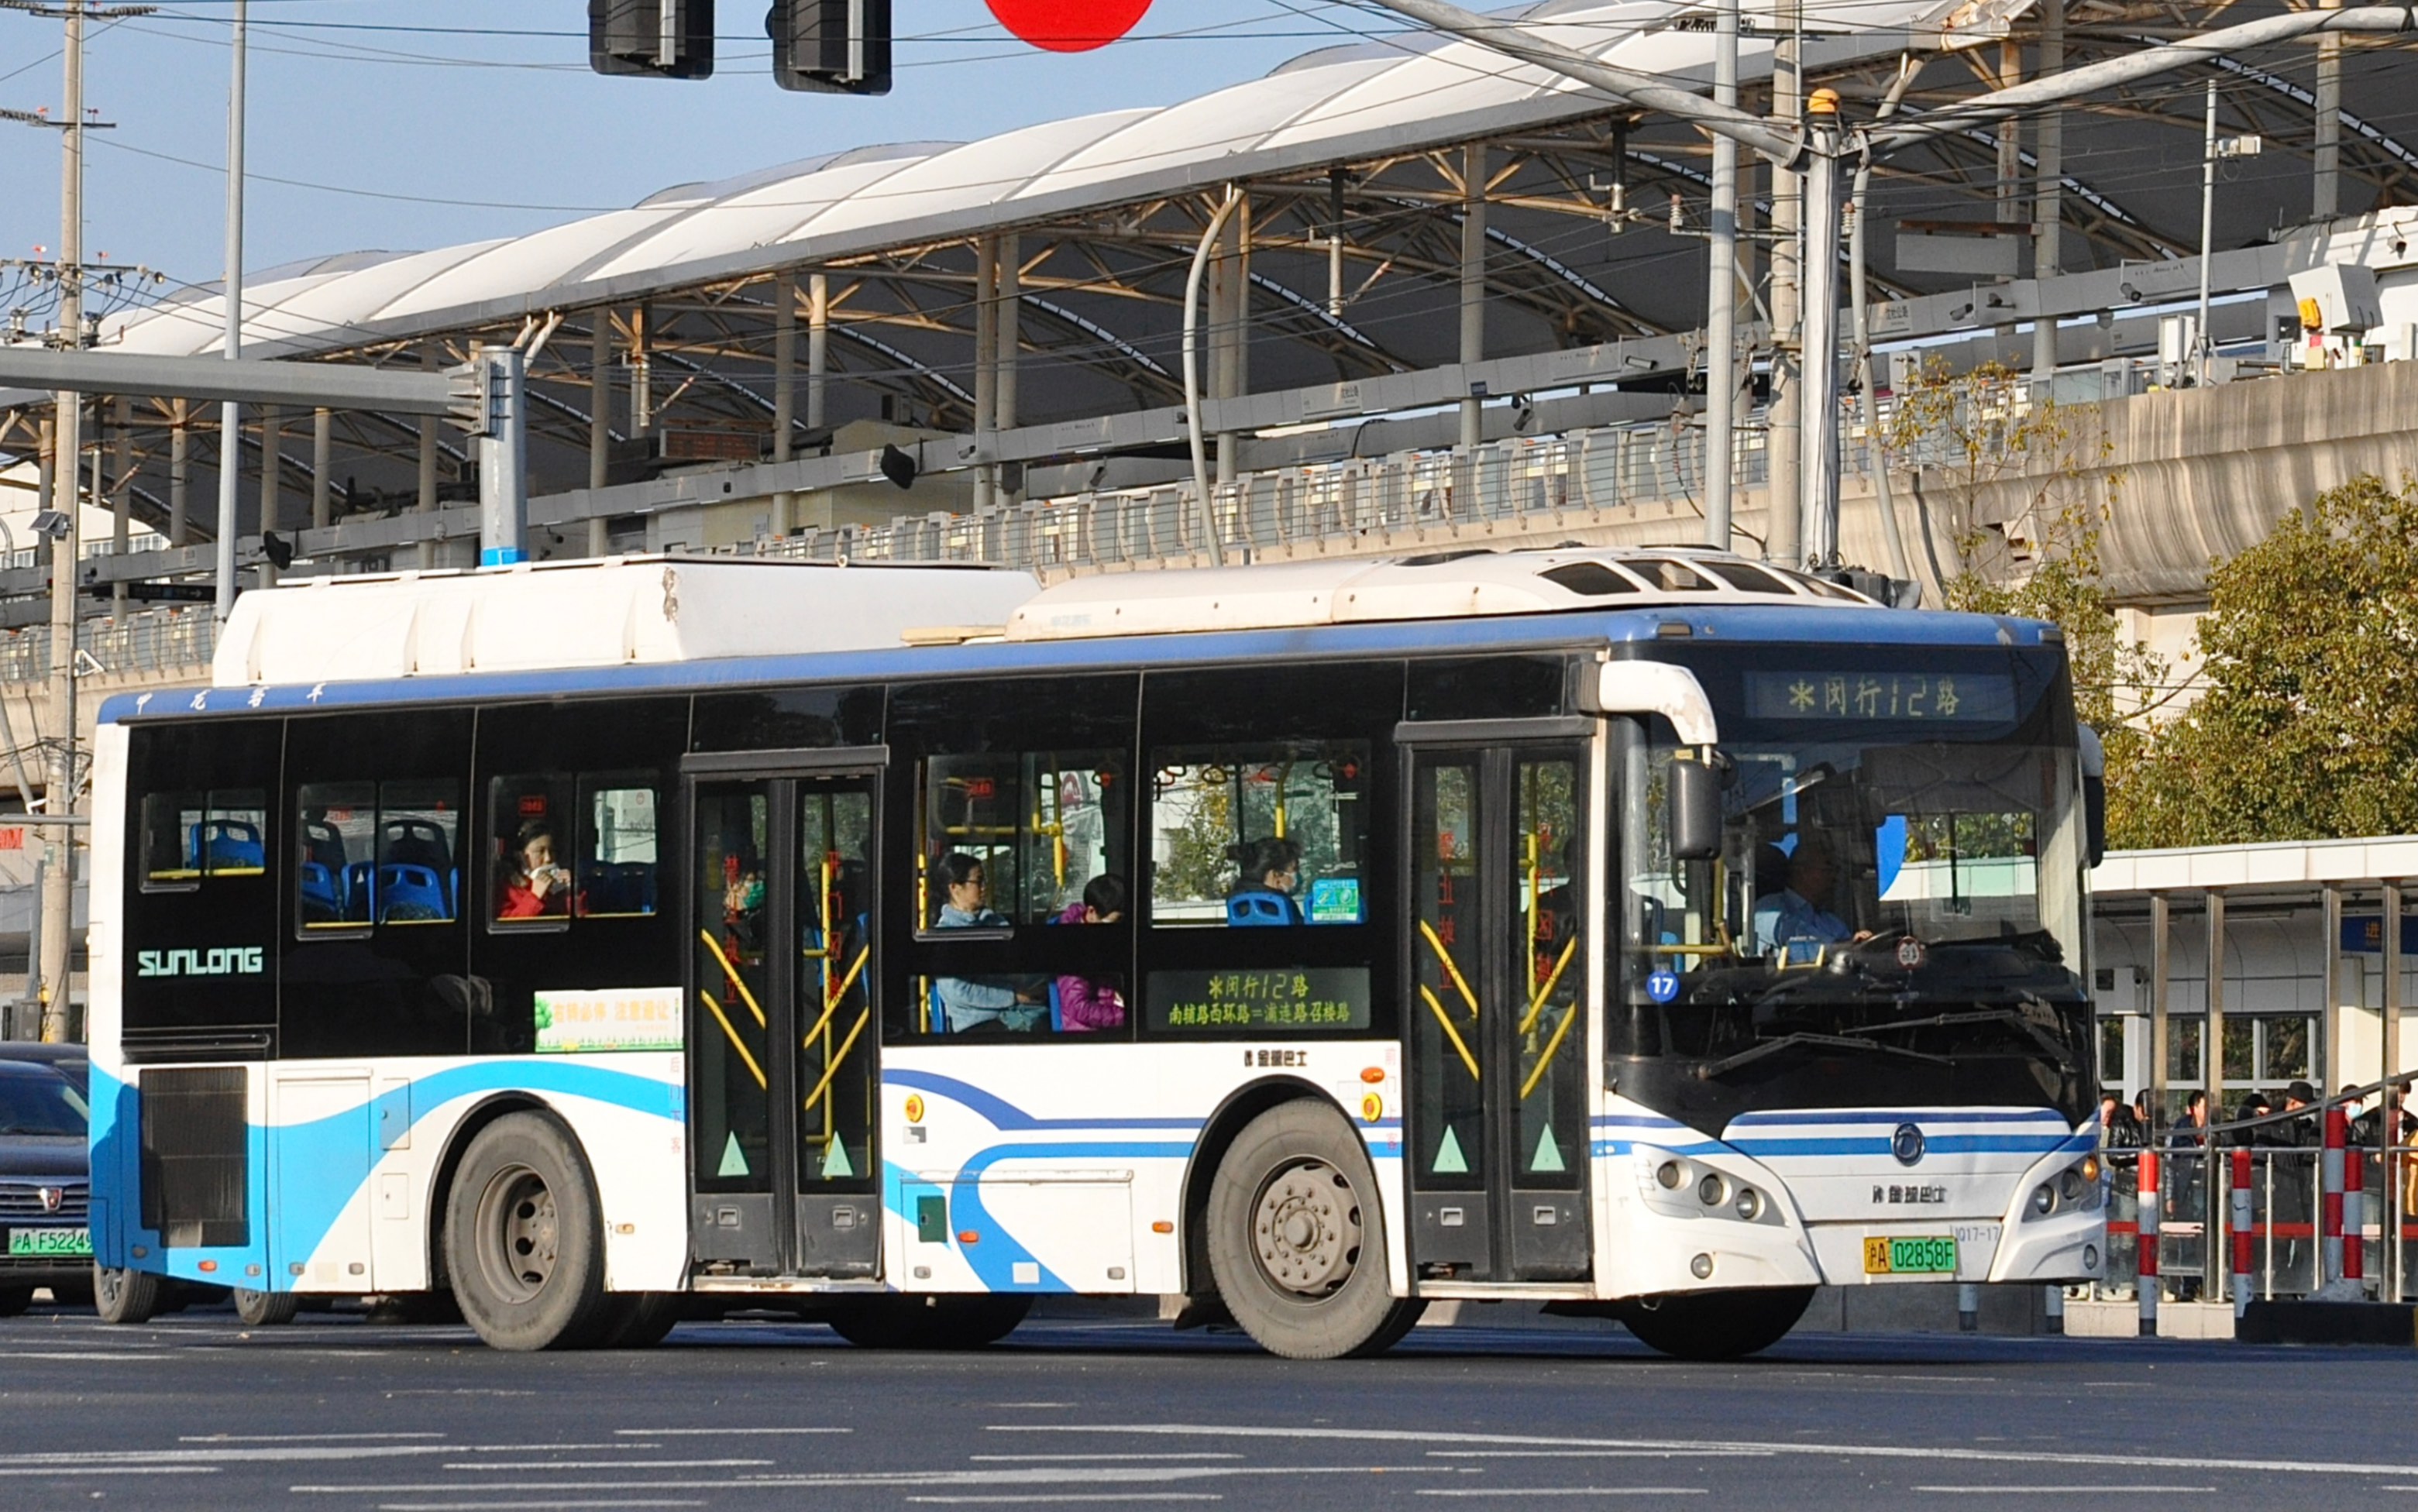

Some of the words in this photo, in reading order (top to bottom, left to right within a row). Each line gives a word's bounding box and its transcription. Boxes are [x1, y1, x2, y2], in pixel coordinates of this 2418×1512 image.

[138, 947, 263, 977] SUNLONG
[1651, 977, 1674, 995] 17
[1894, 1242, 1953, 1267] 02858F
